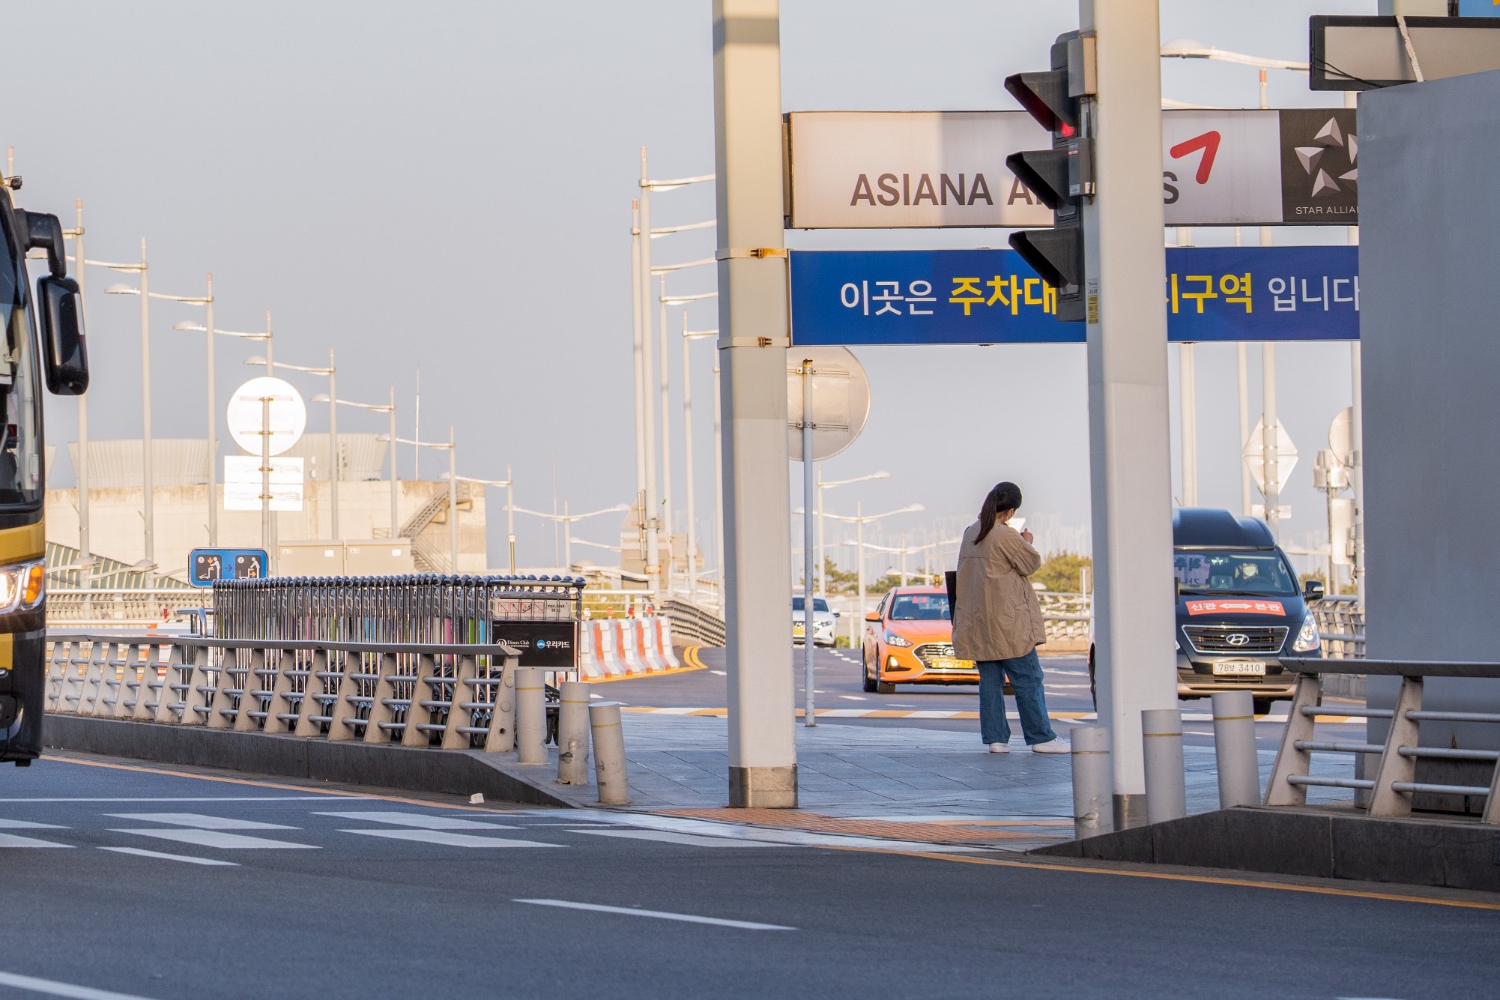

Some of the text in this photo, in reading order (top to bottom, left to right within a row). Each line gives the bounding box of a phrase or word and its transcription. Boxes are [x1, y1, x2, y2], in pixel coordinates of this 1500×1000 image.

[850, 172, 993, 207] ASIANA
[1295, 206, 1359, 215] STAR ALLIA
[839, 277, 937, 317] 이곳은
[1269, 274, 1360, 313] 입니다
[546, 640, 570, 649] 우리카드
[1238, 663, 1261, 672] 3410
